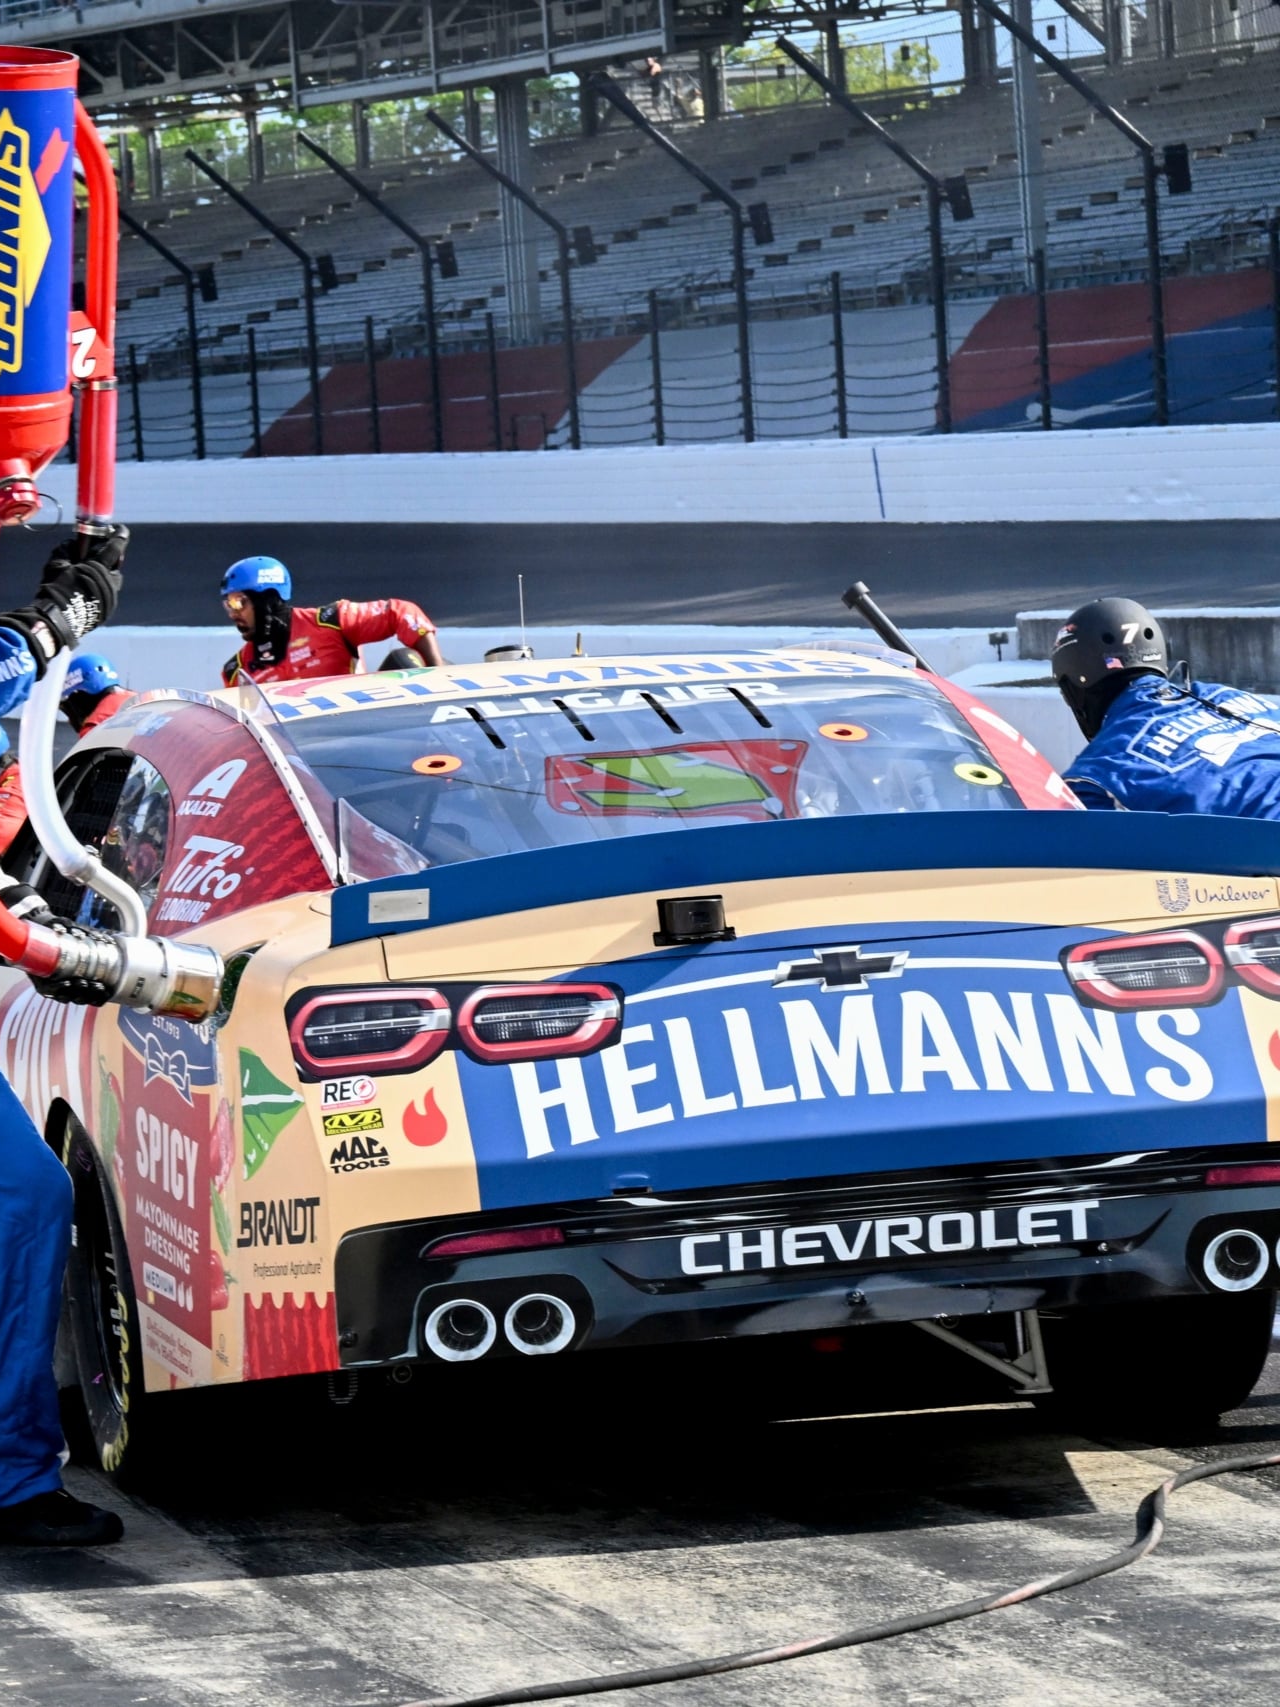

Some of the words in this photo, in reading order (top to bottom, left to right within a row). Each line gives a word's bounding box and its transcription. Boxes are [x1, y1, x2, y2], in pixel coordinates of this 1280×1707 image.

[71, 327, 97, 378] 2
[1121, 623, 1139, 644] 7
[430, 682, 786, 723] ALLGAIER
[176, 800, 224, 817] AXALTA
[164, 835, 245, 899] Tufco
[156, 898, 211, 923] FLOORING
[1195, 886, 1271, 903] Unilever
[134, 1107, 199, 1209] SPICY
[330, 1136, 389, 1164] MAC
[330, 1157, 391, 1174] TOOLS
[135, 1194, 200, 1254] MAYONNAISE
[237, 1197, 320, 1248] BRANDT
[679, 1200, 1103, 1276] CHEVROLET
[144, 1226, 191, 1275] DRESSING
[145, 1270, 174, 1295] MEDIUM
